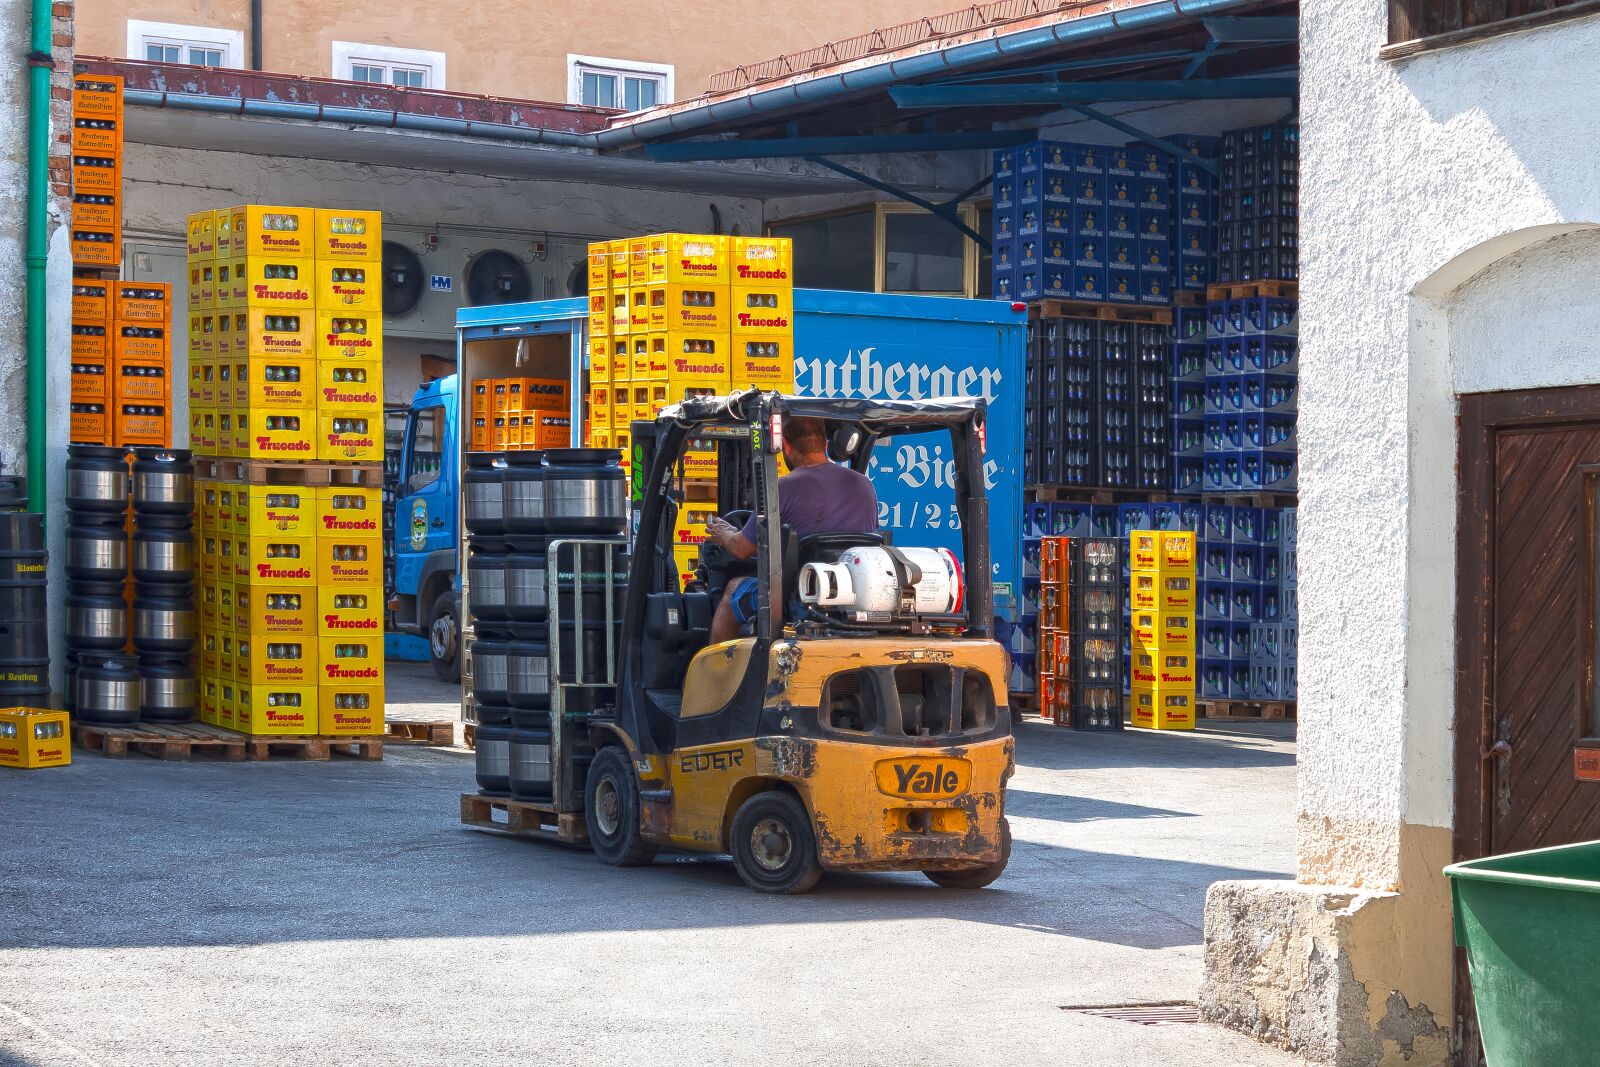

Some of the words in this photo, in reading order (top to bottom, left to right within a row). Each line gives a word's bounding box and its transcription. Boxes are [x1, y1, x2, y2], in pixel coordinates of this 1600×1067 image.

[261, 235, 300, 246] Trucade
[330, 239, 366, 248] Trucade
[682, 260, 717, 270] Trucade
[737, 265, 786, 279] Trucade
[432, 276, 450, 288] HM
[255, 285, 308, 300] Trucade
[333, 286, 364, 294] Trucade
[681, 311, 716, 320] Trucade
[738, 313, 787, 327] Trucade
[263, 336, 300, 346] Trucade
[327, 334, 372, 347] Trucade
[674, 359, 724, 373] Trucade
[746, 362, 780, 371] Trucade
[793, 348, 1002, 406] eutberger
[264, 386, 301, 396] Trucade
[324, 388, 376, 402] Trucade
[256, 437, 310, 450] Trucade
[328, 434, 372, 446] Trucade
[683, 456, 718, 465] Trucade
[632, 444, 643, 501] Yale
[267, 512, 298, 520] Trucade
[323, 515, 376, 529] Trucade
[257, 564, 310, 578] Trucade
[331, 565, 368, 575] Trucade
[265, 615, 303, 625] Trucade
[325, 615, 377, 628] Trucade
[265, 664, 303, 673] Trucade
[325, 664, 378, 678] Trucade
[1161, 673, 1191, 682] Trucade
[266, 711, 304, 720] Trucade
[334, 714, 371, 723] Trucade
[681, 748, 745, 773] EDER
[893, 764, 958, 794] Yale
